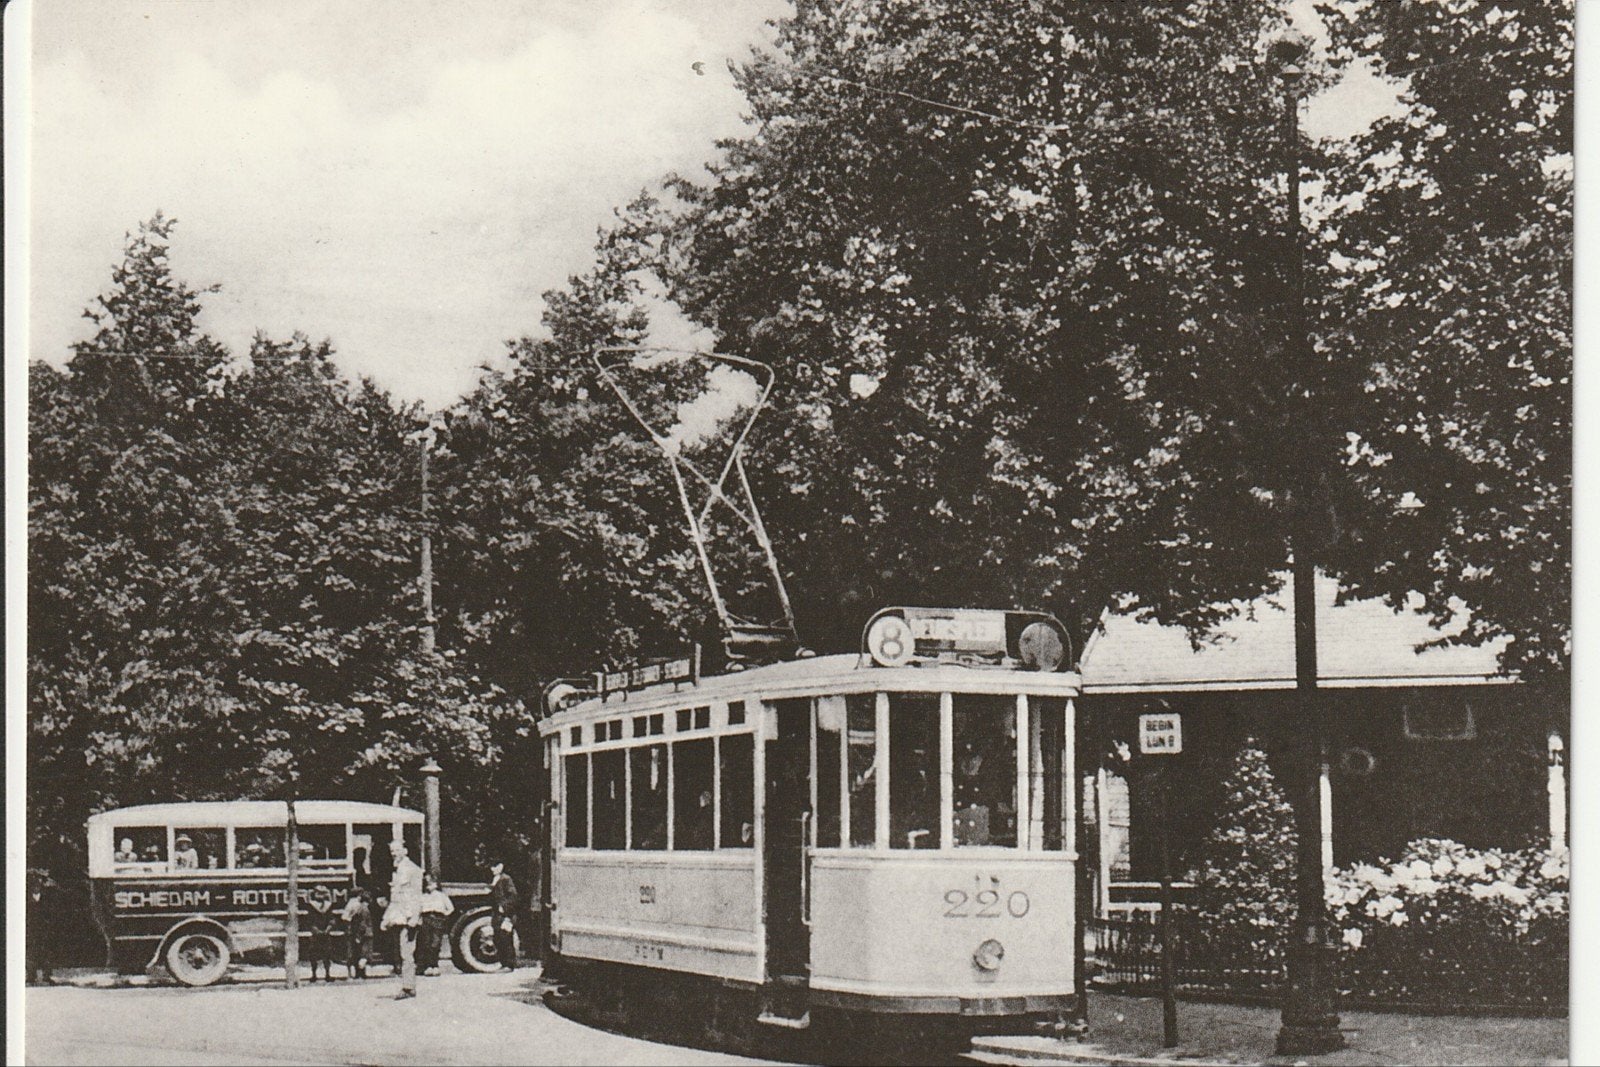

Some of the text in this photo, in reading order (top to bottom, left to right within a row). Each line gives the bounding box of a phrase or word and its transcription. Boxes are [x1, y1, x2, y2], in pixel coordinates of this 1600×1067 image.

[879, 621, 905, 660] 8
[114, 889, 211, 908] SCHIEDAM
[232, 888, 348, 906] ROTTERM
[640, 885, 656, 904] 220
[943, 889, 1030, 918] 220
